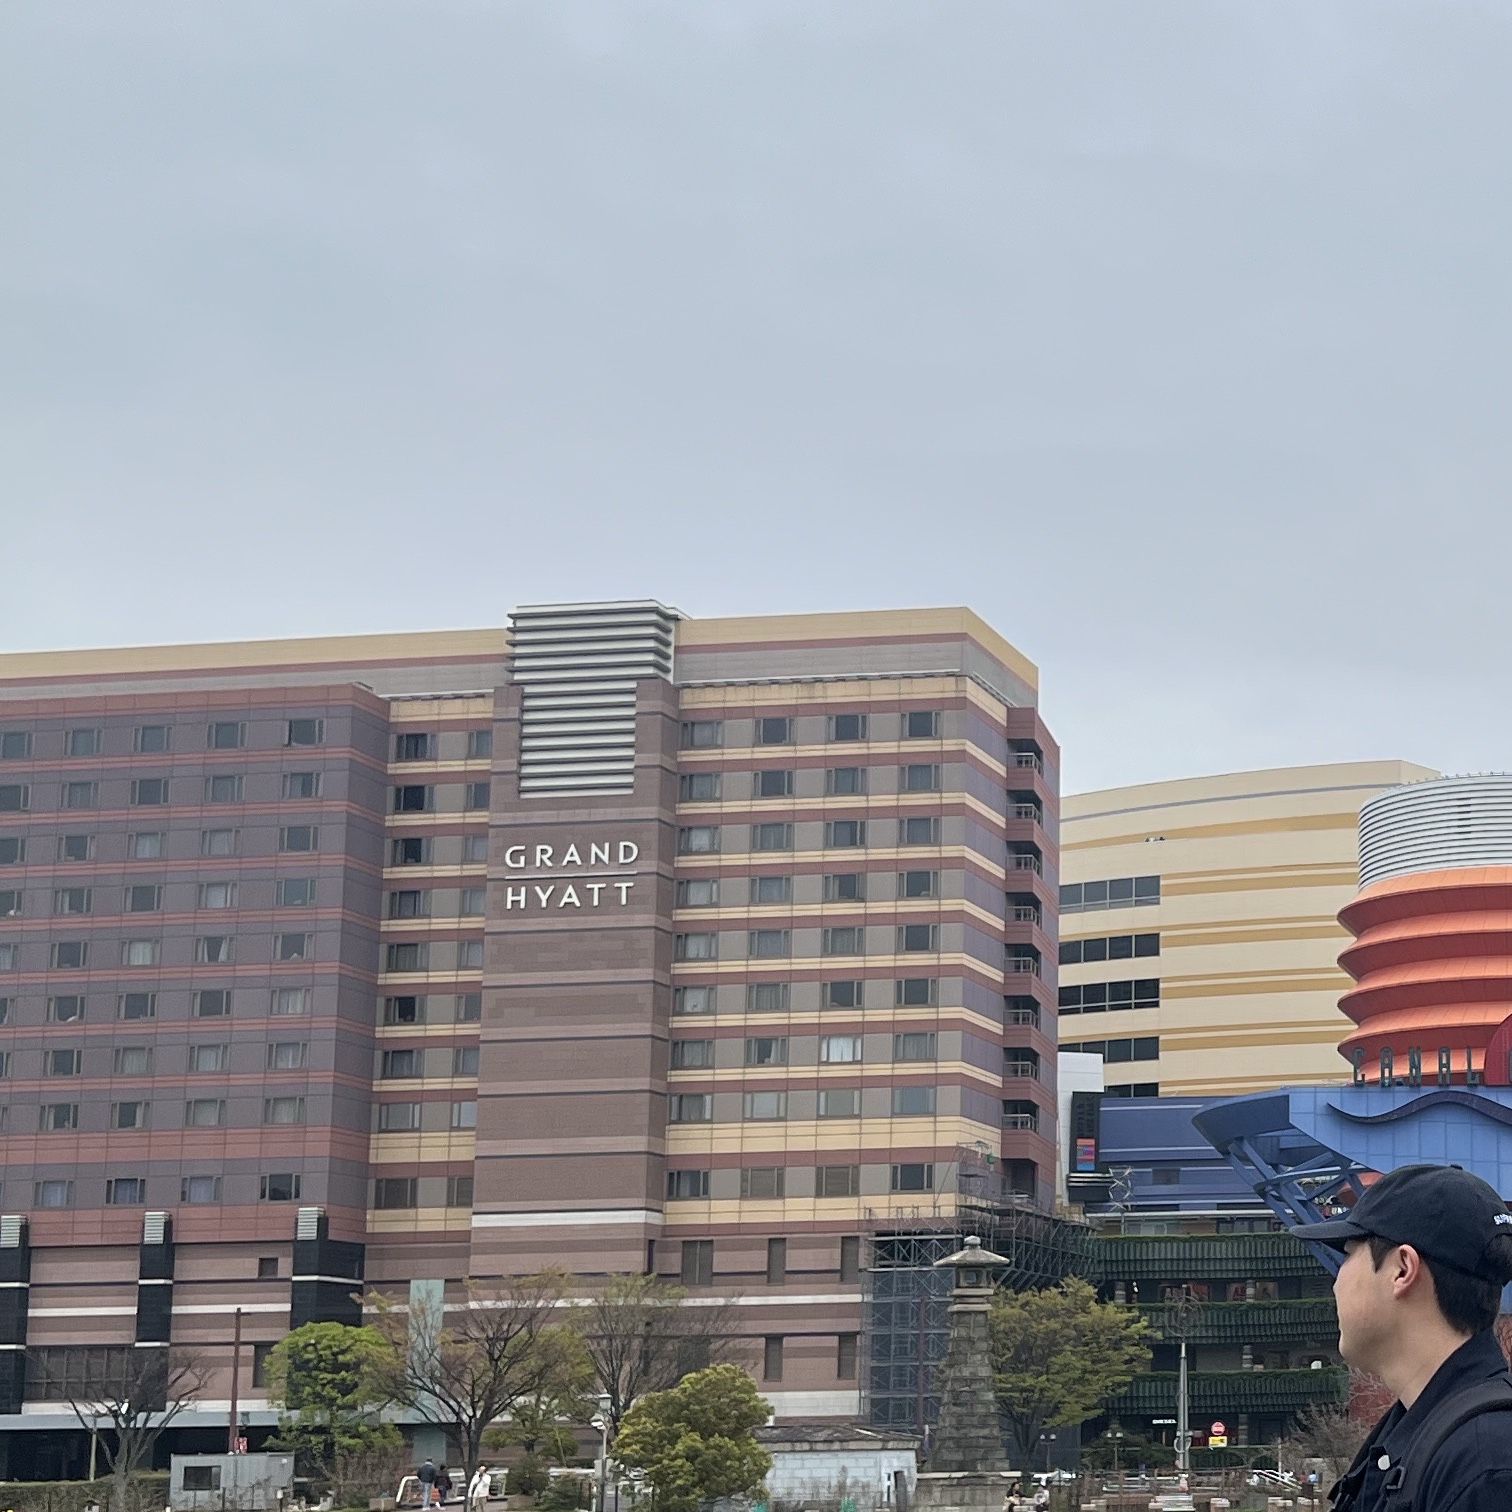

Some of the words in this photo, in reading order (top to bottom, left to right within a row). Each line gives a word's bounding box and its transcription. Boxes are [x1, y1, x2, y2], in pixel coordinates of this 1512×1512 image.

[504, 841, 640, 869] GRAND
[506, 882, 635, 910] HYATT
[1352, 1045, 1480, 1088] CANAL
